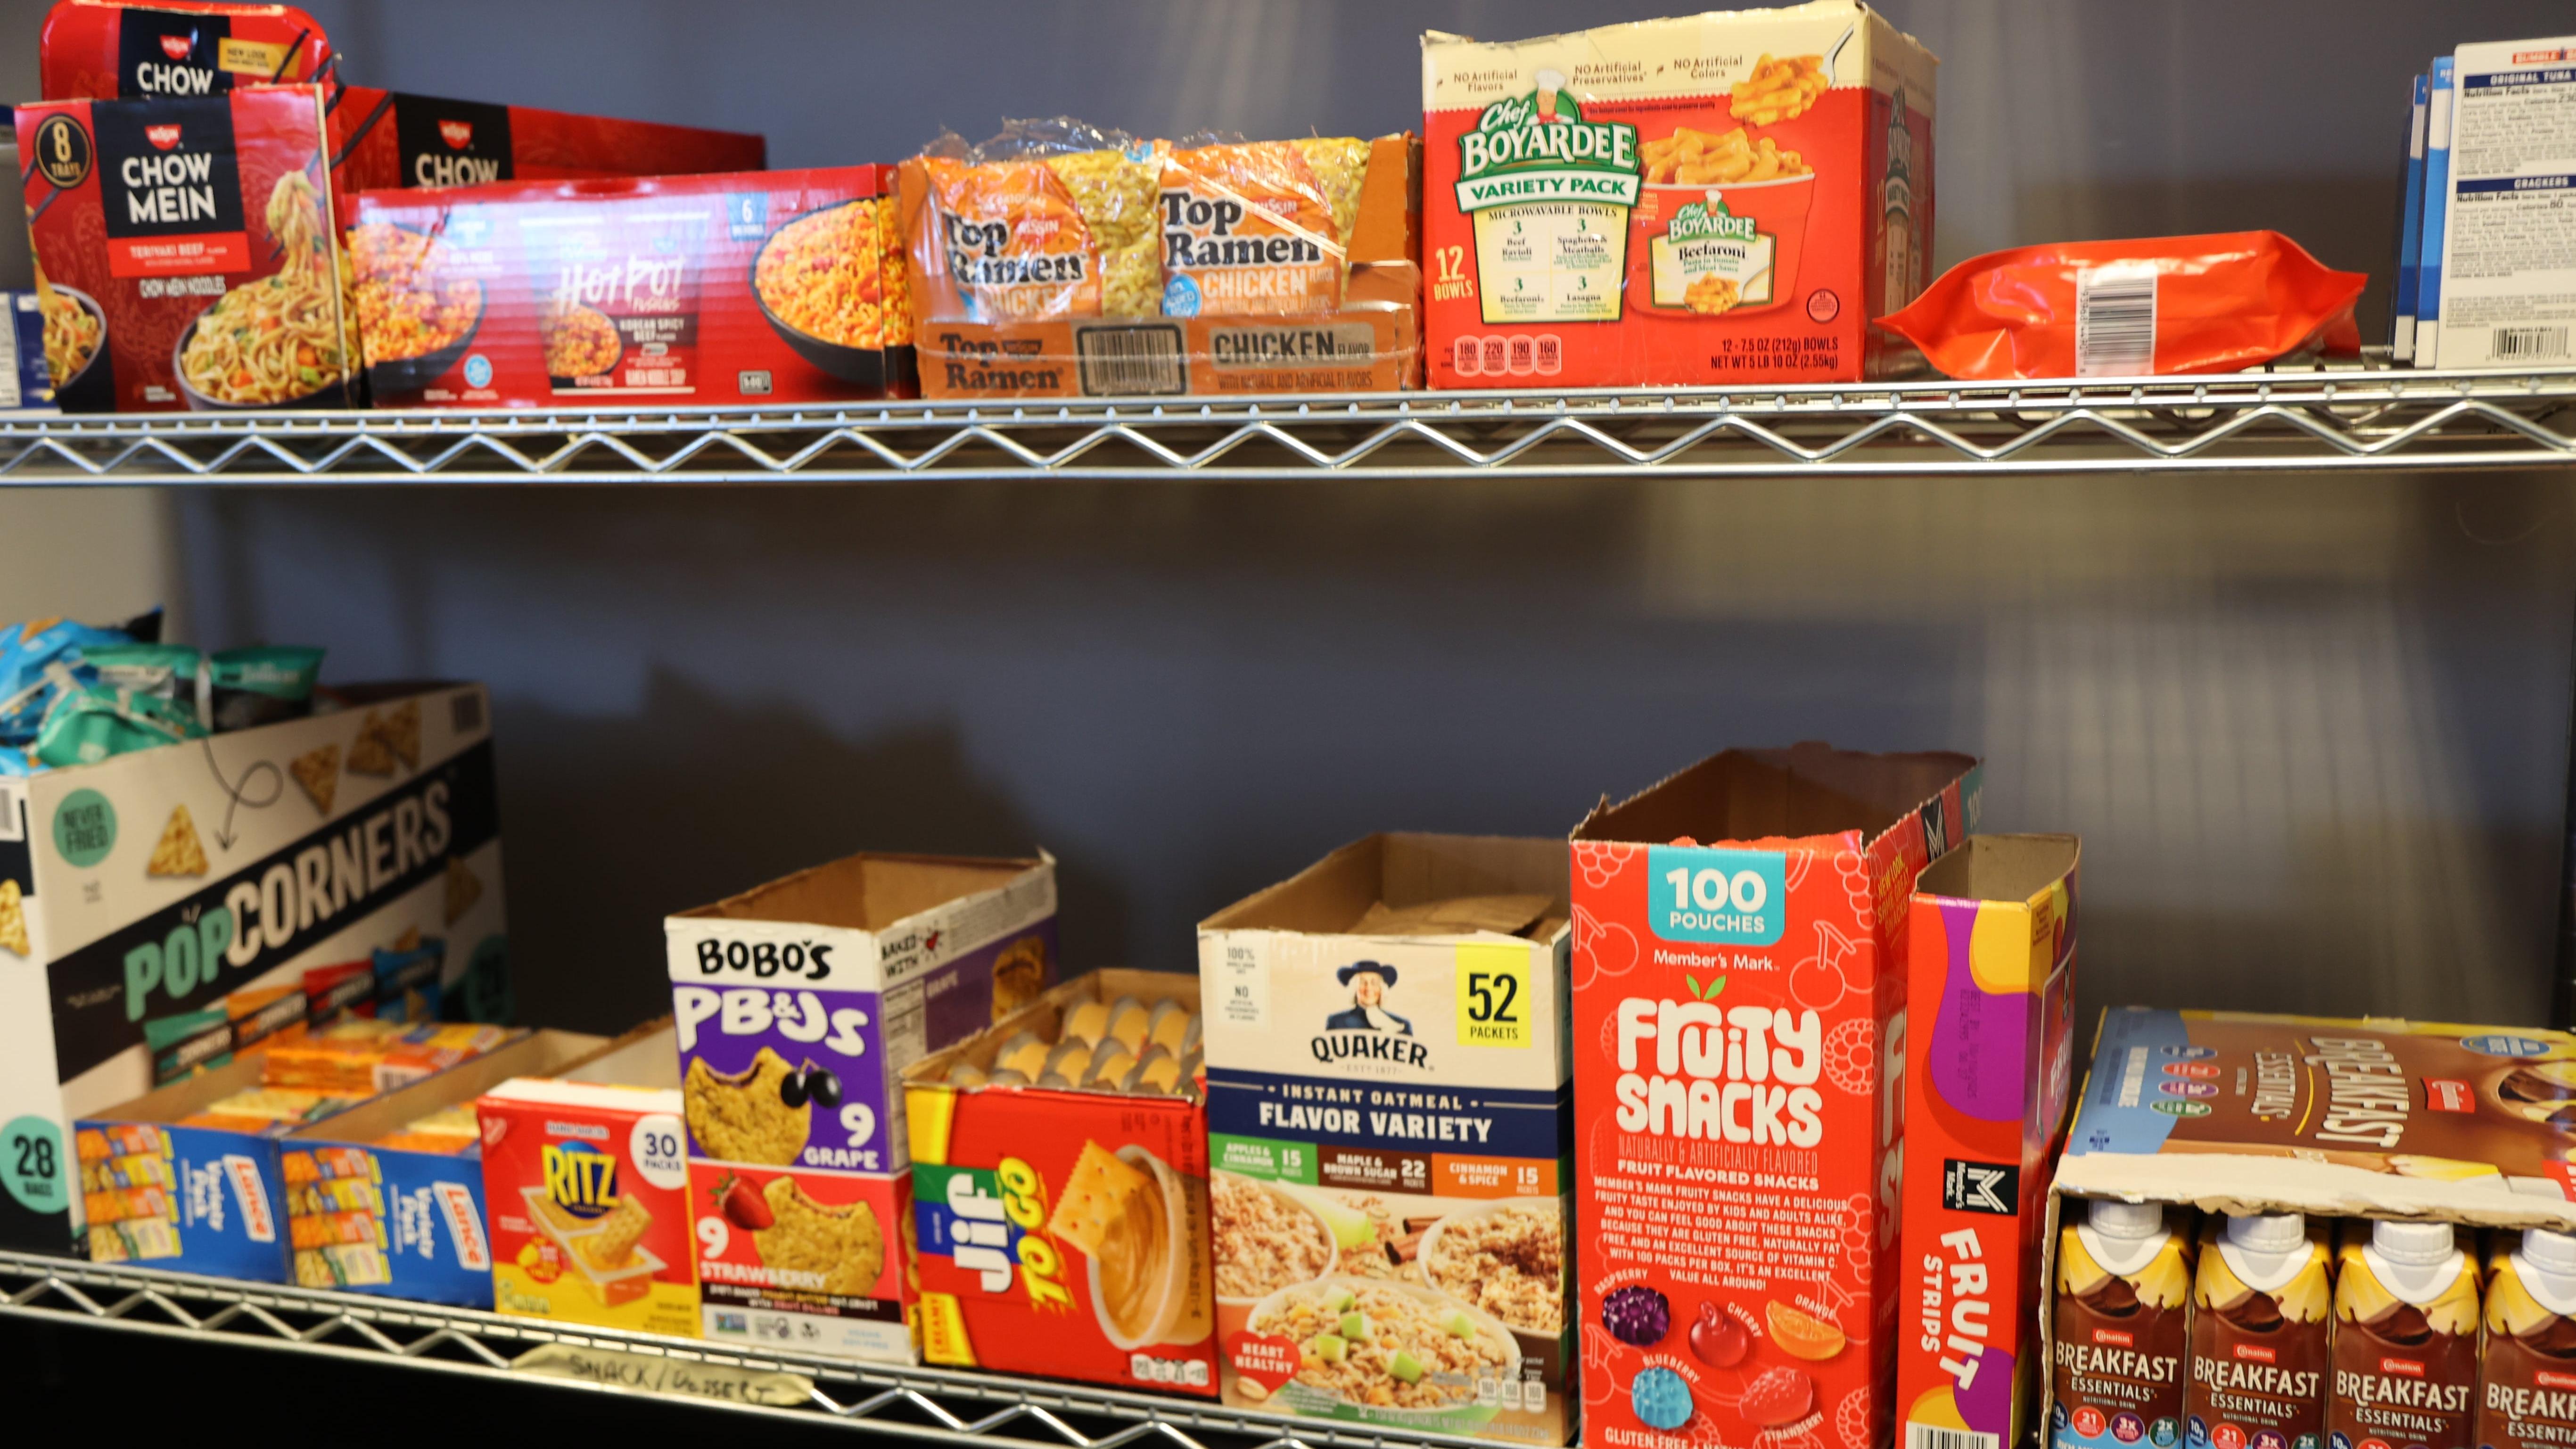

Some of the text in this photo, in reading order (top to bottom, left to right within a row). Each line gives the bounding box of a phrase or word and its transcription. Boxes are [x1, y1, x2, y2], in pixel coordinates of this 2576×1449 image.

[1575, 61, 1641, 75] NO Artificial
[1674, 55, 1743, 70] NO Artificial
[1690, 67, 1726, 79] Colors
[137, 62, 214, 95] CHOW
[1454, 69, 1517, 83] NO Artificial
[1467, 82, 1504, 92] Flavors
[2543, 70, 2572, 82] TUNA
[2464, 85, 2530, 98] Nutrition Facts
[1480, 98, 1531, 132] Chef
[52, 122, 72, 162] 8
[1463, 124, 1636, 177] BOYARDEE
[51, 162, 80, 178] TRAYS
[122, 152, 212, 188] CHOW
[415, 153, 499, 187] CHOW
[2513, 176, 2569, 189] CRACKERS
[1470, 177, 1626, 201] VARIETY PACK
[2456, 191, 2519, 203] Nutrition Facts
[127, 185, 217, 223] MEIN
[742, 199, 753, 223] 6
[1160, 192, 1243, 236] Top
[1488, 205, 1573, 222] MICROWAVABLE
[1578, 206, 1618, 218] BOWLS
[1678, 204, 1705, 222] Chef
[942, 210, 1008, 257] Top
[1513, 220, 1522, 235] 3
[1577, 218, 1587, 233] 3
[1669, 217, 1755, 242] BOYARDEE
[1164, 232, 1321, 267] Ramen
[1502, 247, 1532, 256] Ravioli
[1506, 237, 1526, 246] Beef
[1678, 241, 1746, 261] Beefaroni
[1435, 245, 1466, 283] 12
[1683, 256, 1701, 266] Pasta
[1713, 256, 1739, 265] Tomato
[1203, 269, 1307, 299] CHICKEN
[1433, 279, 1473, 302] BOWLS
[1514, 277, 1523, 293] 3
[1577, 275, 1587, 291] 3
[1566, 293, 1601, 303] Lasagna
[939, 333, 998, 366] Top
[1214, 330, 1335, 364] CHICKEN
[1460, 342, 1476, 355] 180
[1485, 341, 1503, 354] 220
[1513, 341, 1530, 354] 190
[1539, 341, 1556, 354] 160
[1721, 336, 1838, 355] 12 7.5 OZ (212g) BOWLS
[1711, 354, 1838, 371] NET WT 5 LB 10 OZ (2.55kg)
[945, 363, 1060, 390] Ramen
[62, 804, 106, 829] NEVER
[64, 826, 110, 854] FRIED
[123, 780, 453, 1023] POPCORNERS
[1666, 867, 1768, 914] 100
[1670, 911, 1765, 933] POUCHES
[1227, 947, 1255, 961] 100%
[1653, 949, 1773, 972] Member's Mark
[1235, 985, 1249, 998] NO
[1467, 972, 1519, 1023] 52
[1469, 1025, 1519, 1040] PACKETS
[1311, 1033, 1429, 1069] QUAKER
[1282, 1083, 1462, 1111] INSTANT OATMEAL
[2250, 1051, 2296, 1119] ESSENTIALS
[2303, 1035, 2411, 1149] BREAKFAST
[839, 1102, 876, 1148] 9
[1259, 1102, 1492, 1143] FLAVOR VARIETY
[13, 1134, 56, 1179] 28
[644, 1132, 677, 1158] 30
[1226, 1142, 1262, 1155] APPLES
[1282, 1148, 1302, 1167] 15
[1618, 1134, 1818, 1176] NATURALLY & ARTIFICIALLY FLAVORED
[643, 1158, 682, 1172] PACKS
[803, 1146, 880, 1170] GRAPE
[1223, 1152, 1275, 1168] CINNAMON
[1323, 1162, 1398, 1179] BROWN SUGAR
[1336, 1153, 1383, 1168] MAPLE &
[1401, 1159, 1426, 1179] 22
[1449, 1162, 1508, 1176] CINNAMON
[541, 1144, 621, 1207] RITZ
[1459, 1174, 1499, 1186] & SPICE
[1517, 1166, 1539, 1185] 15
[1617, 1159, 1820, 1191] FRUIT FLAVORED SNACKS
[1955, 1161, 1966, 1210] Member's
[235, 1162, 269, 1235] Lance
[1594, 1176, 1849, 1212] MEMBER'S MARK FRUITY SNACKS HAVE A DELICIOUS
[446, 1188, 482, 1265] Lance
[697, 1216, 730, 1260] 9
[946, 1173, 1013, 1293] Jif
[998, 1156, 1077, 1310] TO GO
[700, 1260, 827, 1290] STRAWBERRY
[1794, 1293, 1835, 1321] ORANGE
[1920, 1253, 1944, 1353] STRIPS
[1939, 1227, 1990, 1391] FRUIT
[1727, 1301, 1764, 1339] CHERRY
[1242, 1342, 1284, 1360] HEART
[2056, 1340, 2178, 1384] BREAKFAST
[1234, 1355, 1293, 1375] HEALTHY
[1642, 1353, 1702, 1385] BLUEBERRY
[2194, 1355, 2320, 1399] BREAKFAST
[2071, 1376, 2152, 1403] ESSENTIALS
[2082, 1394, 2136, 1410] NUTRITIONAL DRINK
[2336, 1369, 2470, 1413] BREAKFAST
[2082, 1411, 2097, 1424] 21
[2210, 1392, 2294, 1420] ESSENTIALS
[1764, 1411, 1825, 1441] STRAWBERRY
[2355, 1407, 2444, 1434] ESSENTIALS
[1605, 1426, 1654, 1449] GLUTEN
